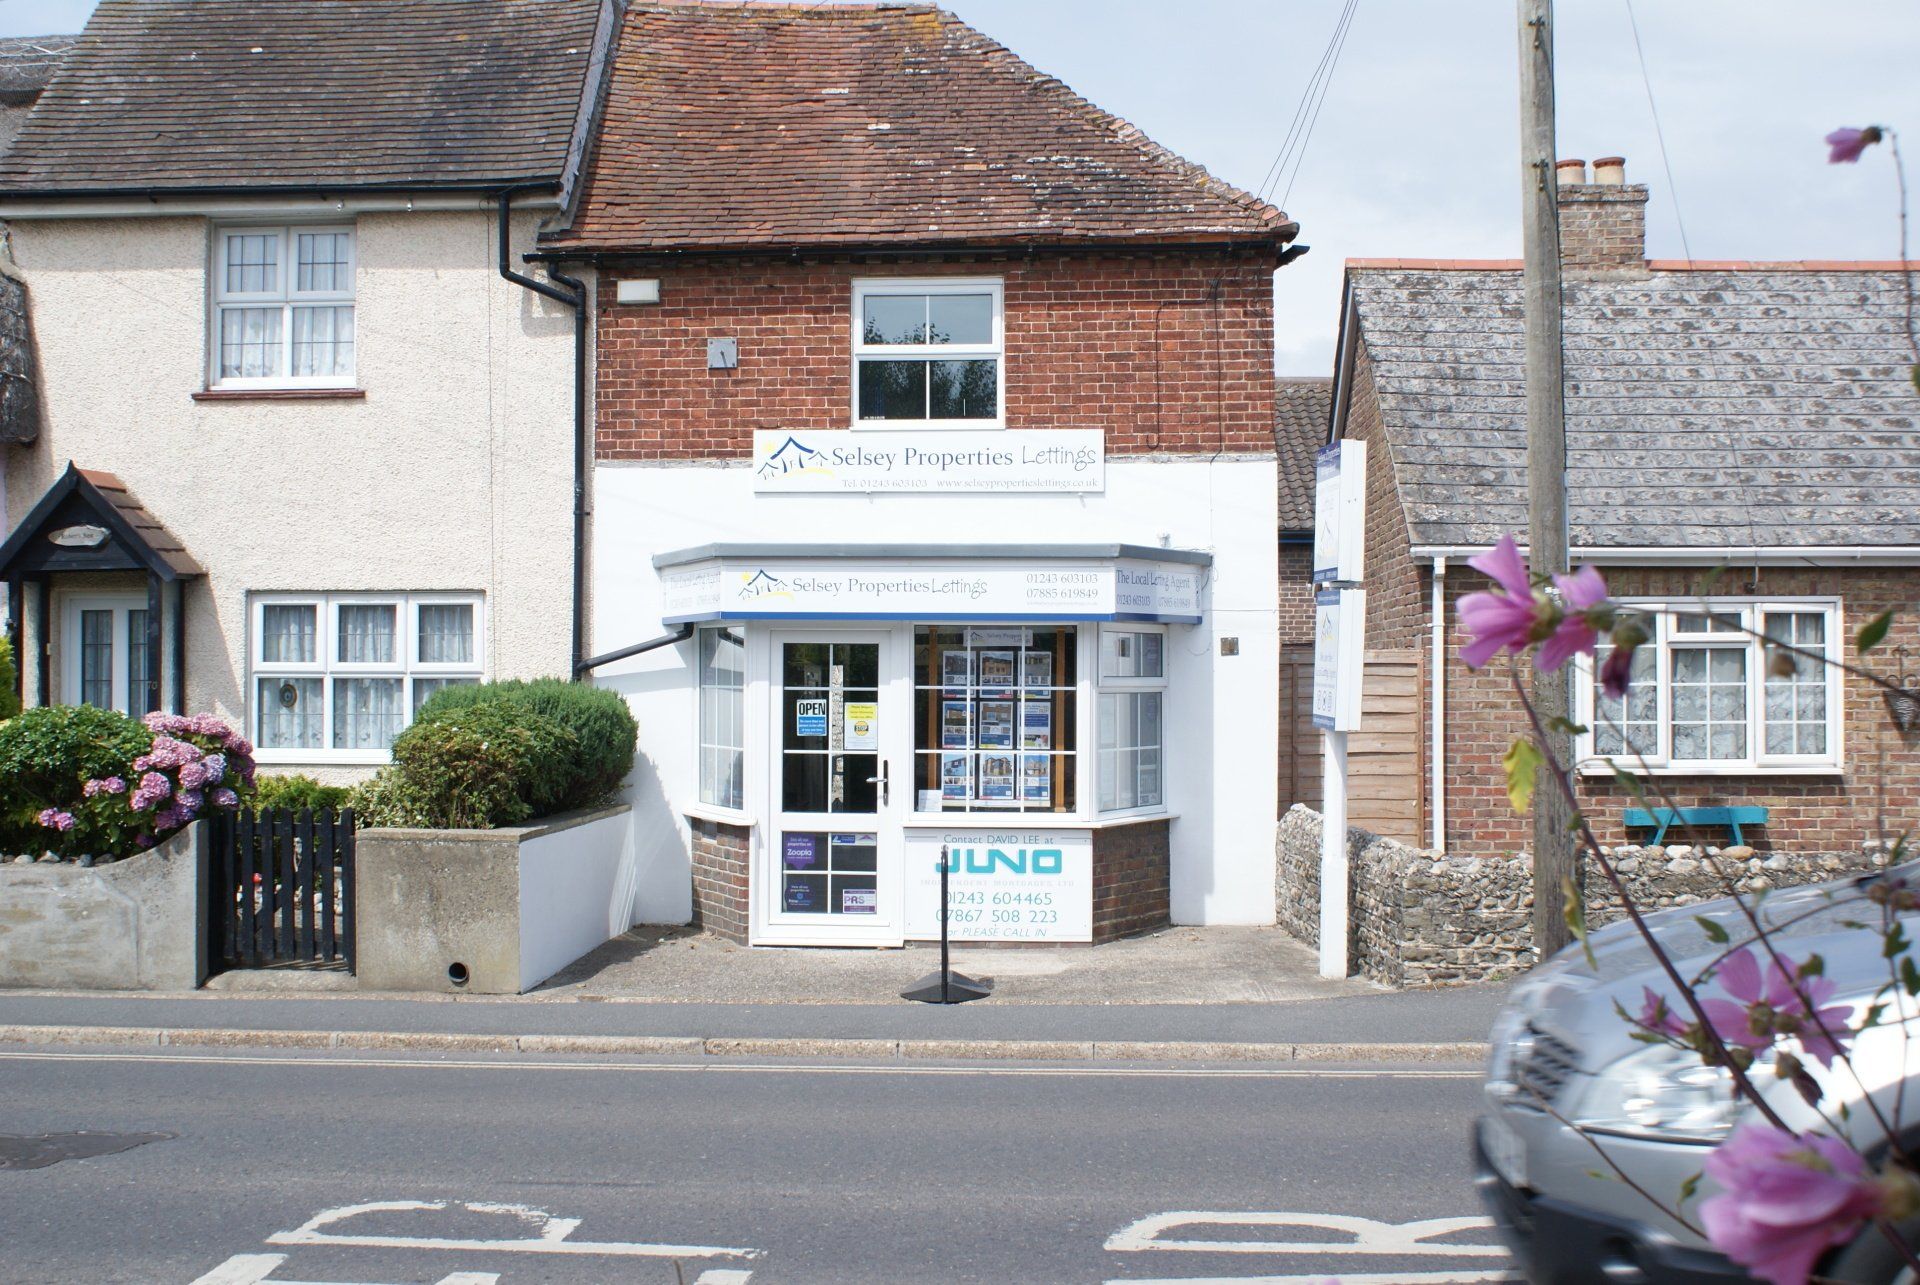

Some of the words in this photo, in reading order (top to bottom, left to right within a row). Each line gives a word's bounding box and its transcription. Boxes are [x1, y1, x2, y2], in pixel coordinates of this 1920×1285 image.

[831, 446, 896, 471] Selsey
[904, 447, 1013, 472] Properties
[1021, 444, 1096, 471] Lettings
[859, 478, 890, 488] 01243
[891, 478, 928, 488] 603103
[1026, 573, 1058, 584] 01243
[1060, 573, 1098, 584] 603103
[1116, 569, 1130, 585] The
[1131, 571, 1149, 586] Local
[1171, 575, 1190, 592] Agent
[792, 578, 843, 597] Selsey
[847, 578, 931, 597] Properties
[931, 578, 989, 600] Lettings
[1026, 588, 1058, 599] 07885
[1060, 588, 1098, 599] 619849
[798, 702, 826, 716] OPEN
[943, 834, 983, 844] Contact
[987, 834, 1019, 845] DAVID
[1023, 835, 1041, 845] LEE
[1044, 836, 1054, 845] at
[787, 848, 813, 857] Zoopla
[935, 848, 1062, 873] JUNO
[920, 879, 988, 888] INDEENDENT
[1057, 879, 1074, 888] LTD
[991, 891, 1053, 905] 604465
[935, 908, 984, 923] 07867
[991, 908, 1021, 923] 508
[1029, 908, 1057, 923] 223
[961, 927, 999, 937] PLEASE
[1003, 928, 1030, 938] CALL
[1035, 927, 1047, 937] IN
